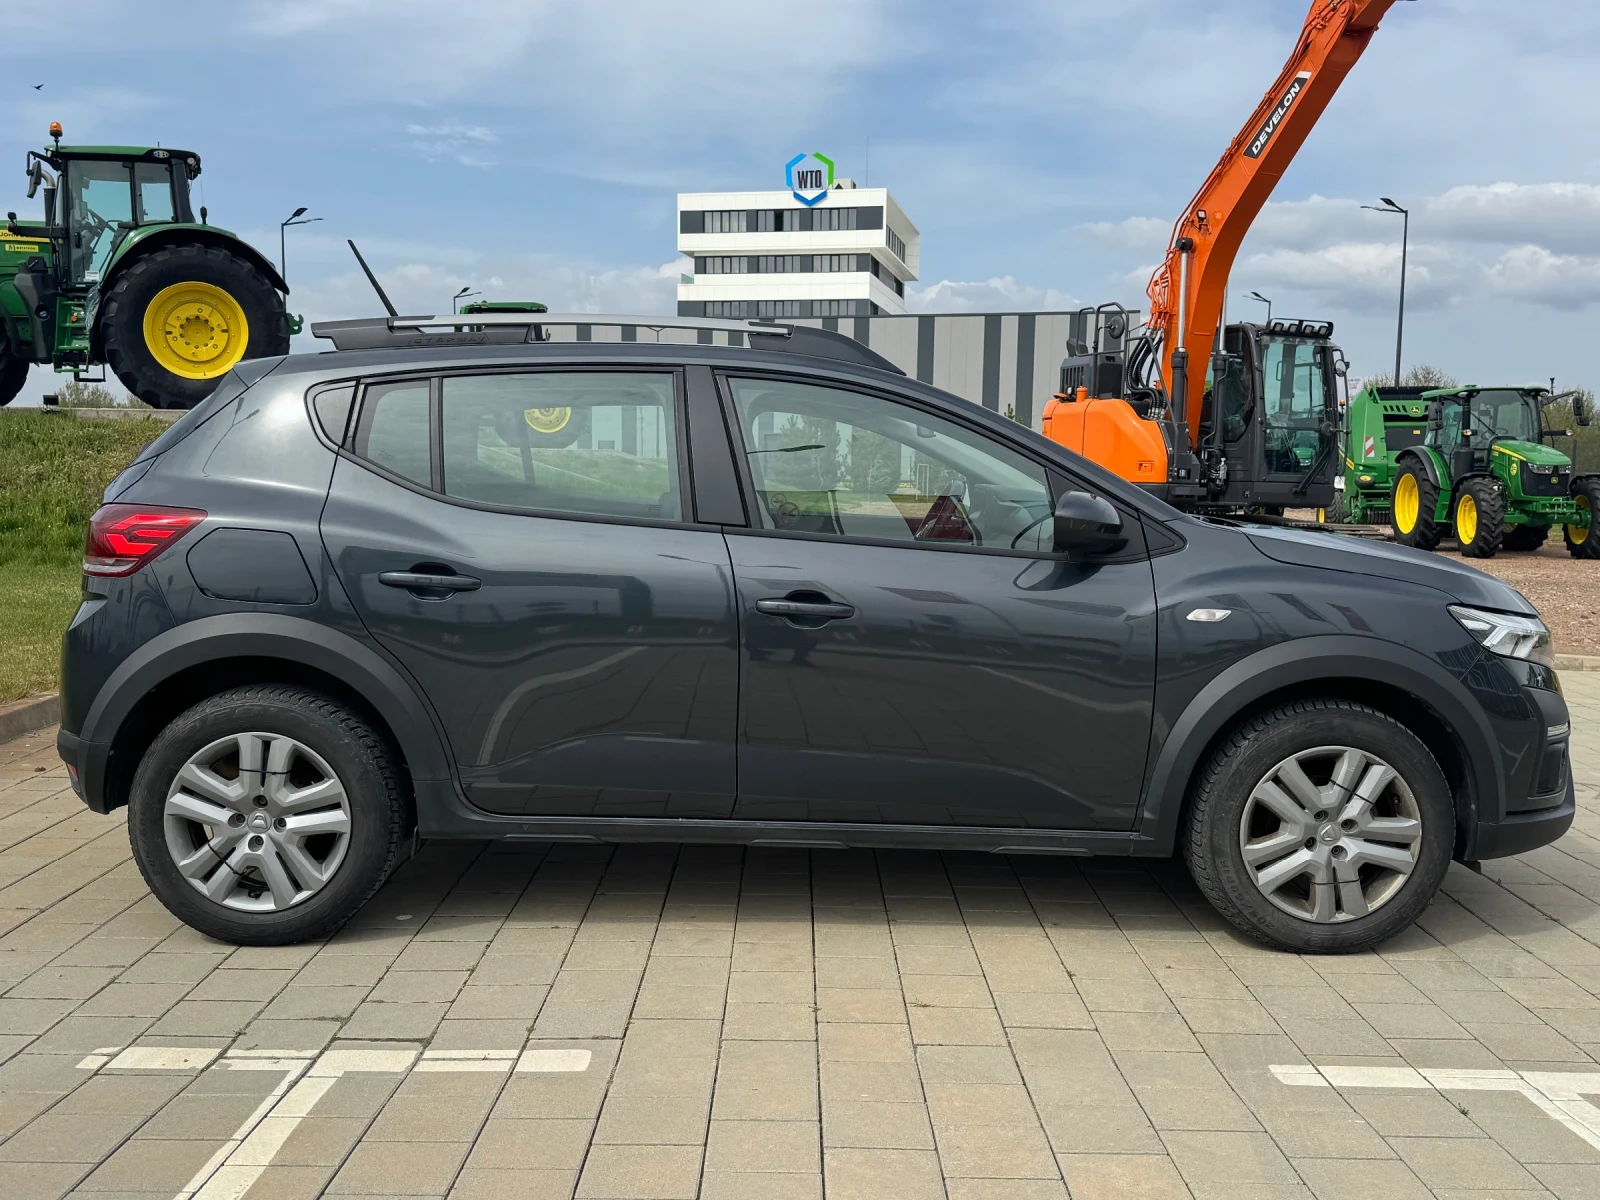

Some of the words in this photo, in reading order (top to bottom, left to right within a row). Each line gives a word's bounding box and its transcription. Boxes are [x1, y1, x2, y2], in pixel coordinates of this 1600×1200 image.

[1252, 83, 1301, 155] DEVELON
[797, 169, 822, 189] WTO
[413, 336, 485, 344] STEPWAY
